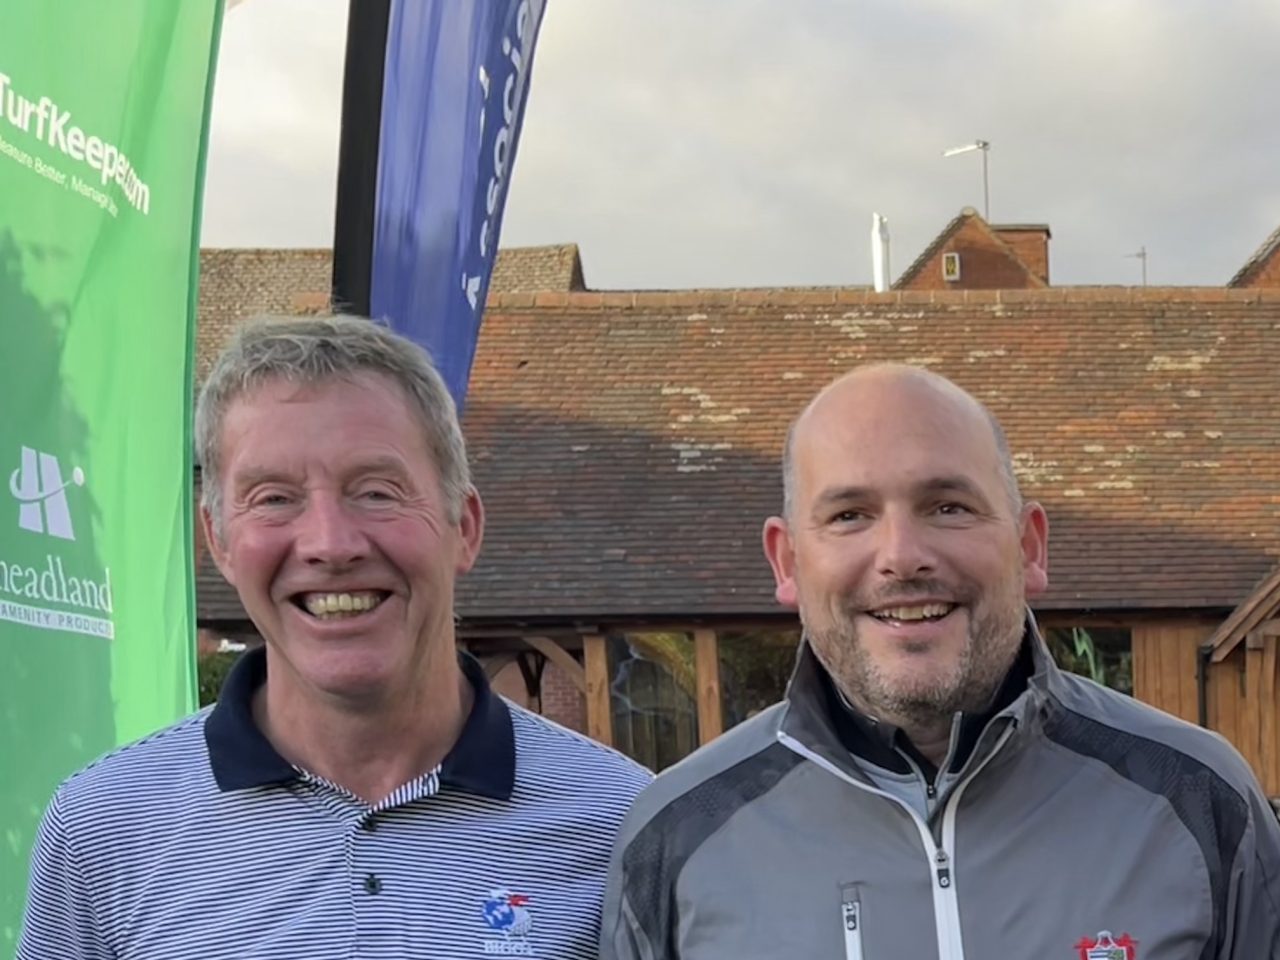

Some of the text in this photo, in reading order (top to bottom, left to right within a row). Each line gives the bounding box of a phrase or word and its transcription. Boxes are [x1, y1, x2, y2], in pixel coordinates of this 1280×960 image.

[0, 135, 33, 168] easure
[1, 604, 112, 636] AMENITY PRODUC
